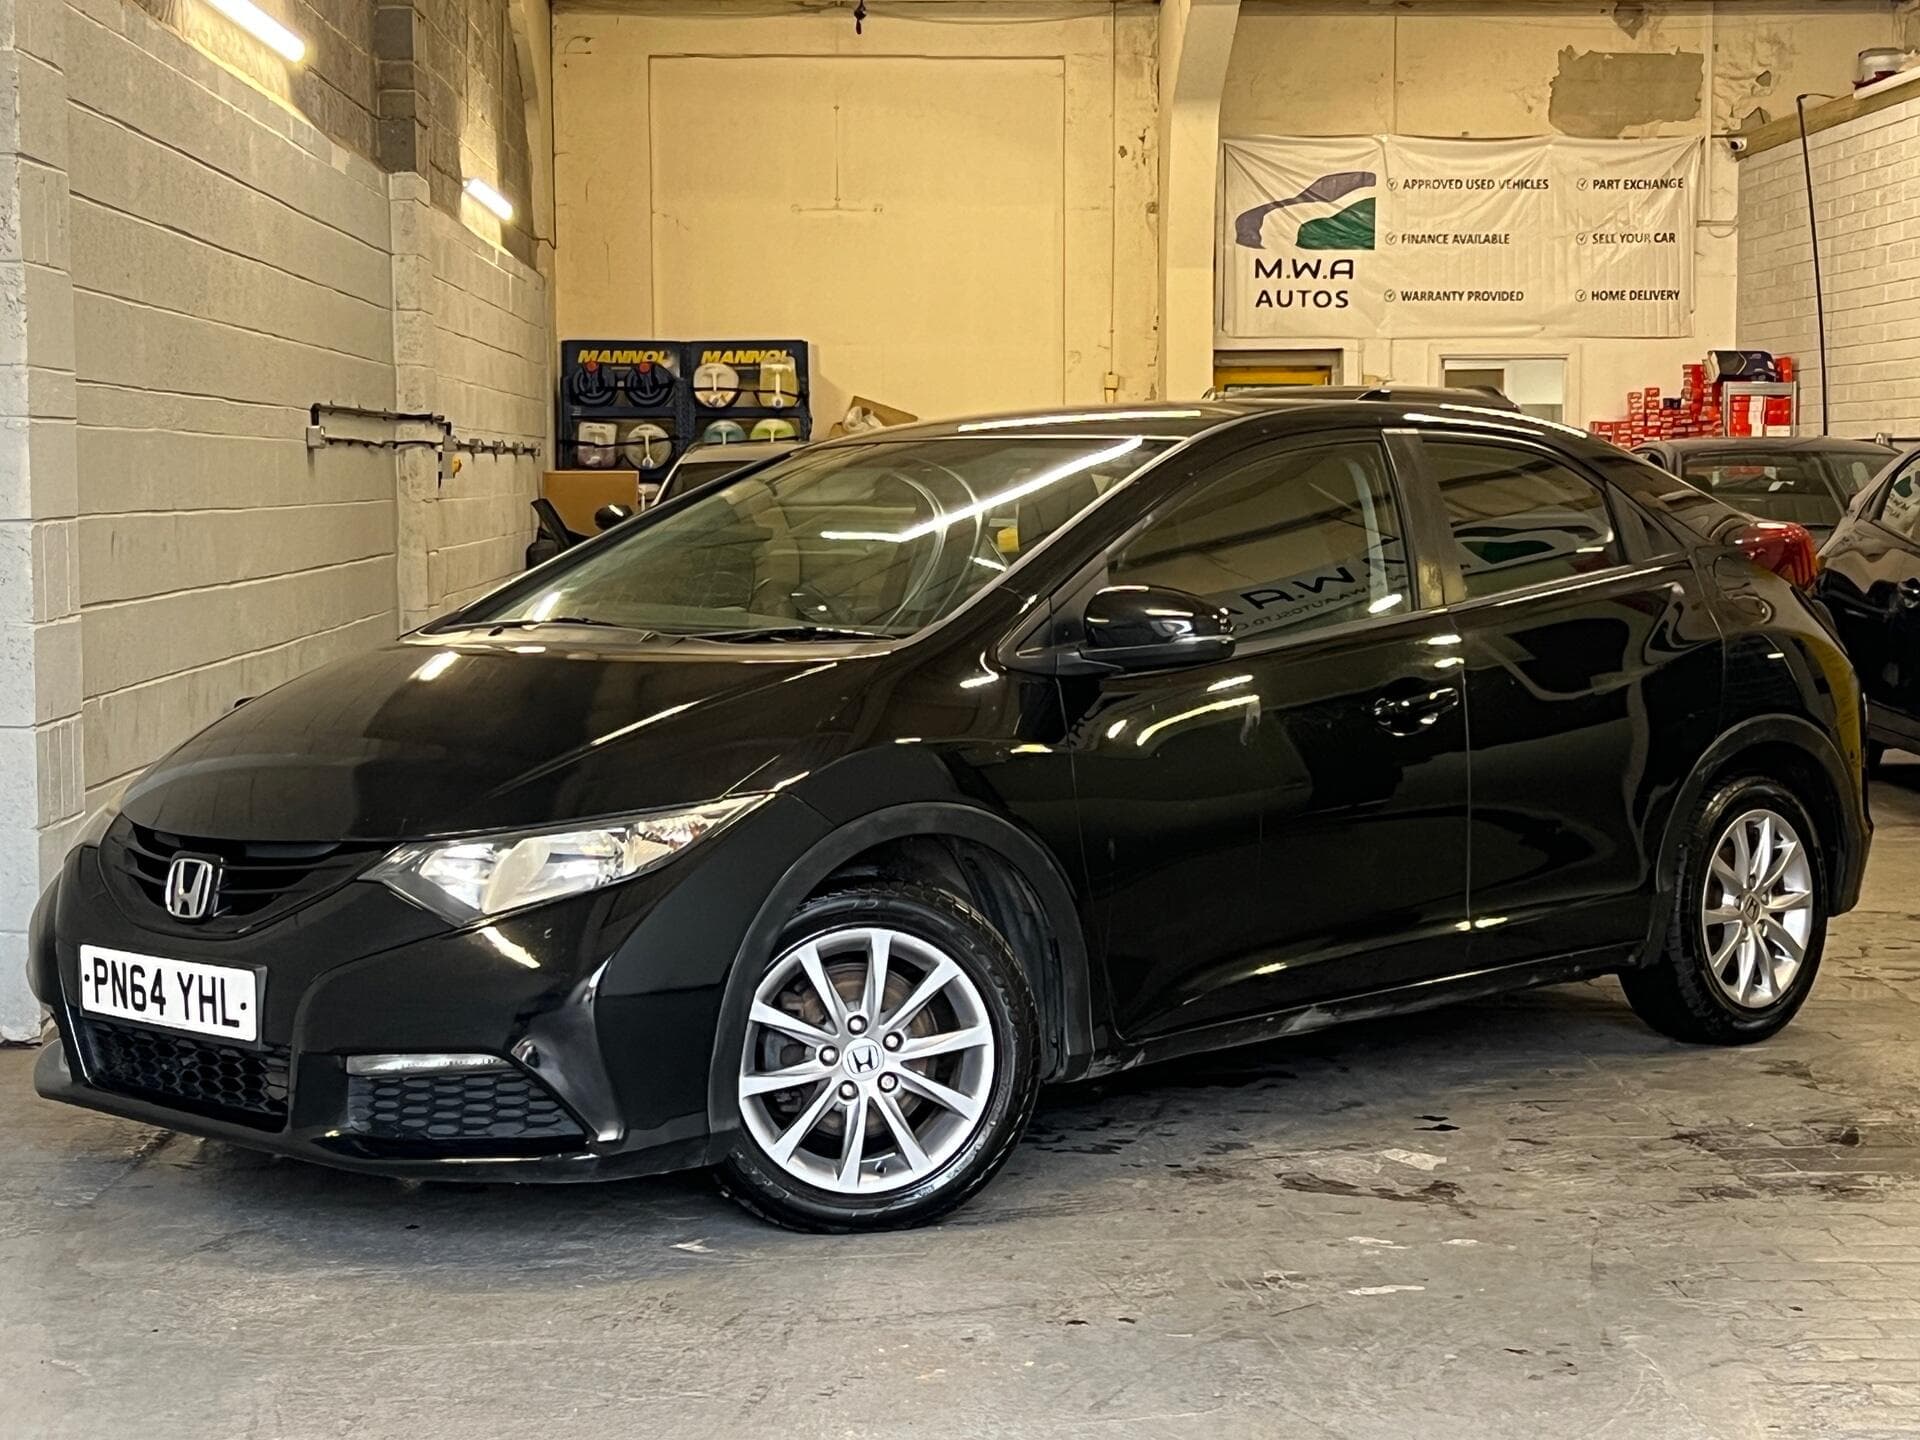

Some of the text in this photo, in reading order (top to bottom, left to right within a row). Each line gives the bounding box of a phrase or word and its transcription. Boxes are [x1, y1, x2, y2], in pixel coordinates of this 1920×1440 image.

[1402, 179, 1549, 190] APPROVED USED VEHICLES
[1592, 178, 1684, 190] PART EXCHANGE
[1401, 233, 1510, 244] FINANCE AVAILABLE
[1592, 232, 1676, 244] SELL YOUR CAR
[1255, 258, 1354, 279] M.W.A
[1255, 289, 1349, 308] AUTOS
[1400, 291, 1524, 301] WARRANTY PROVIDED
[1591, 290, 1680, 301] HOME DELIVERY
[578, 350, 669, 363] MANNOL
[93, 957, 240, 1028] PN64 YHL
